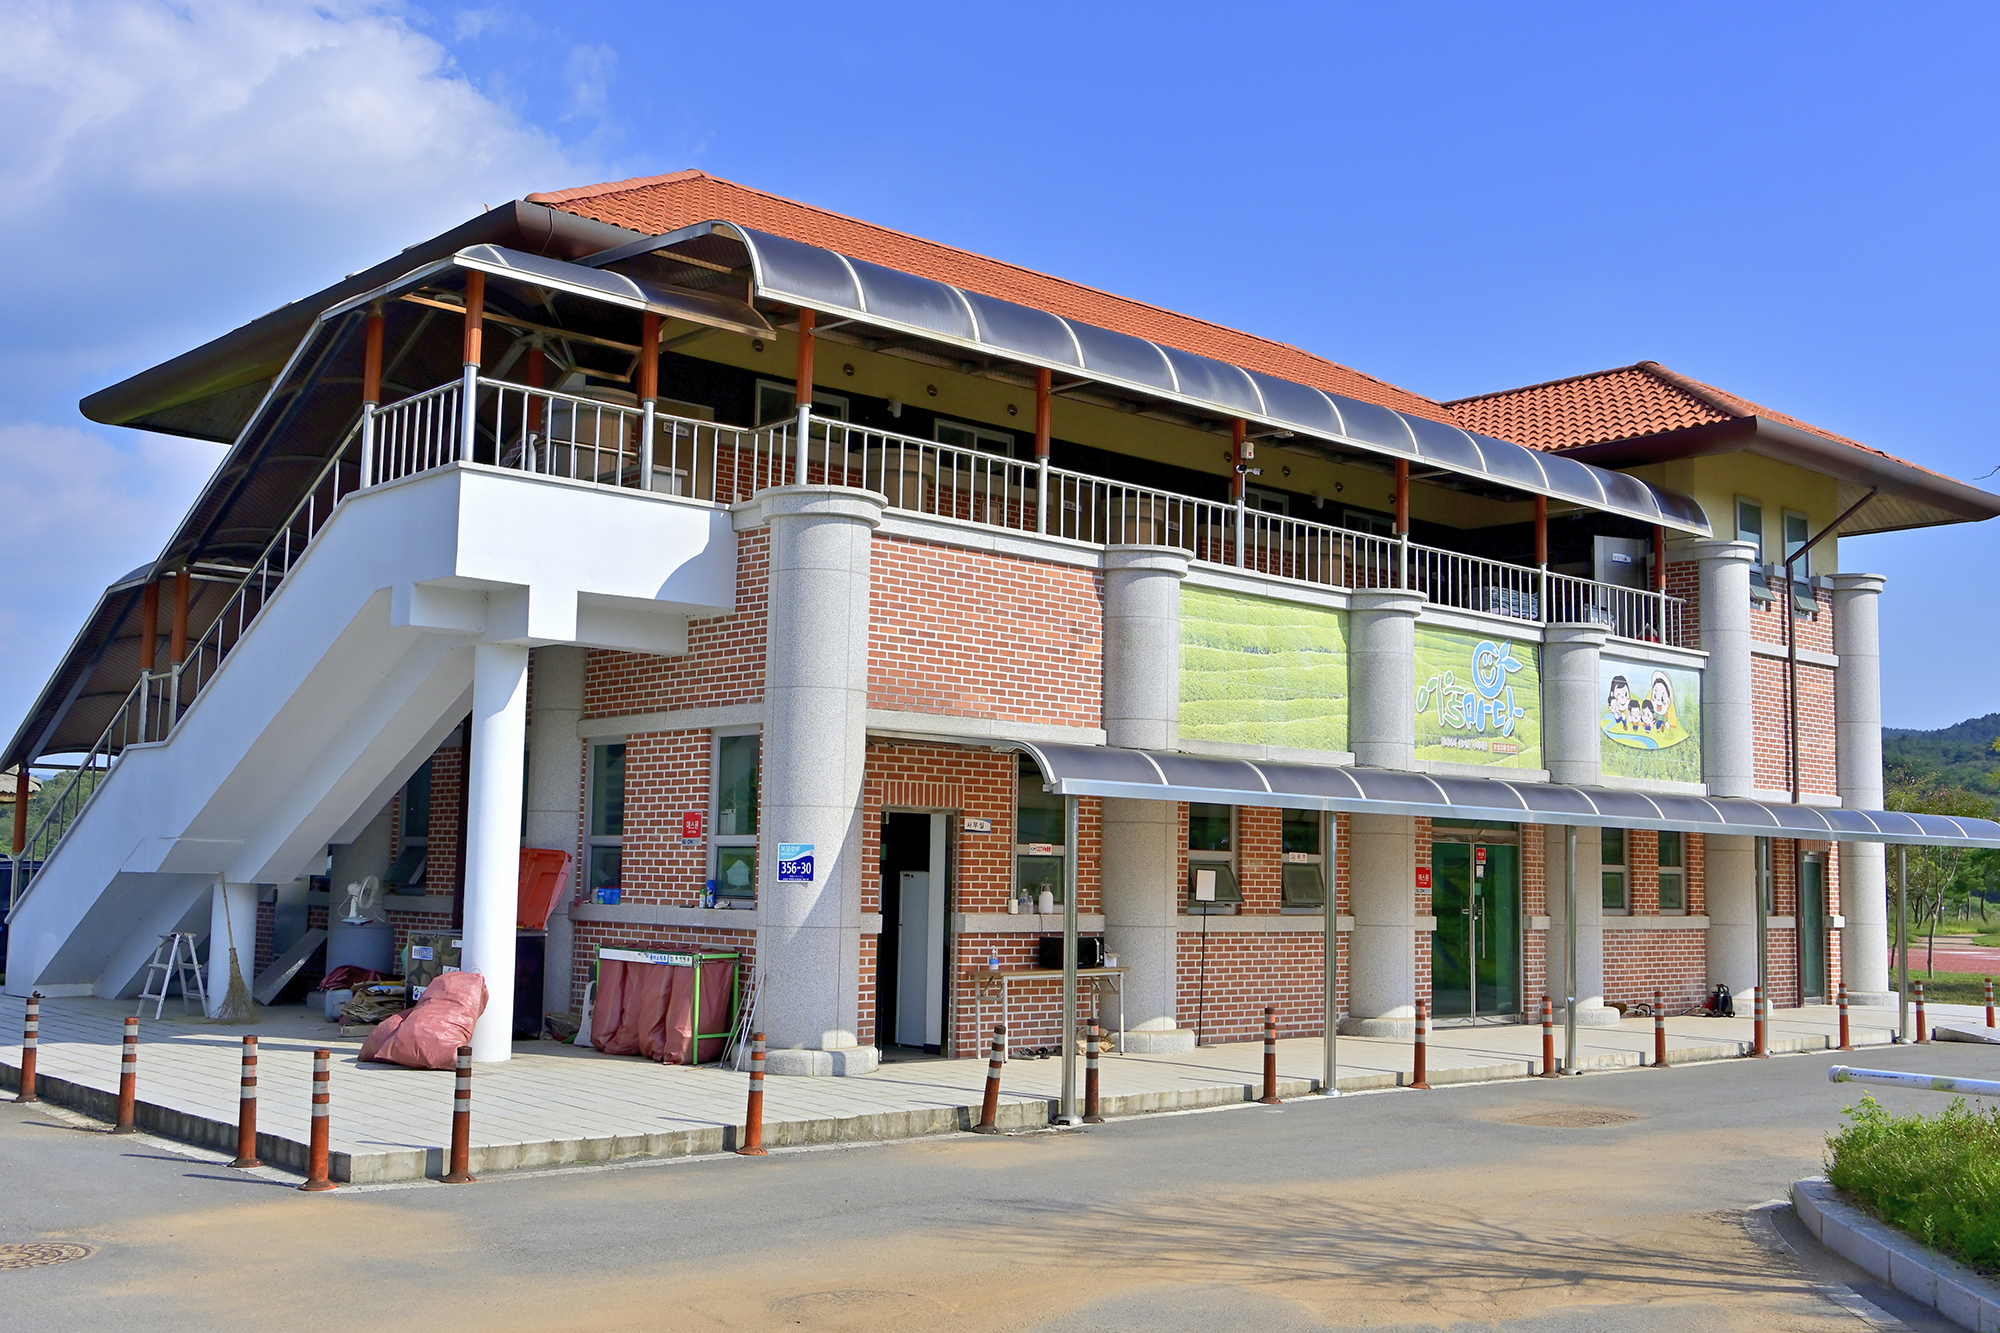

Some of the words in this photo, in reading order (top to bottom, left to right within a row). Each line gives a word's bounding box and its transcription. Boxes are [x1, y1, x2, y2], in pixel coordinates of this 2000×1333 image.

[1416, 669, 1523, 737] 어울마당
[686, 820, 699, 830] 에스원
[781, 862, 811, 874] 356-30
